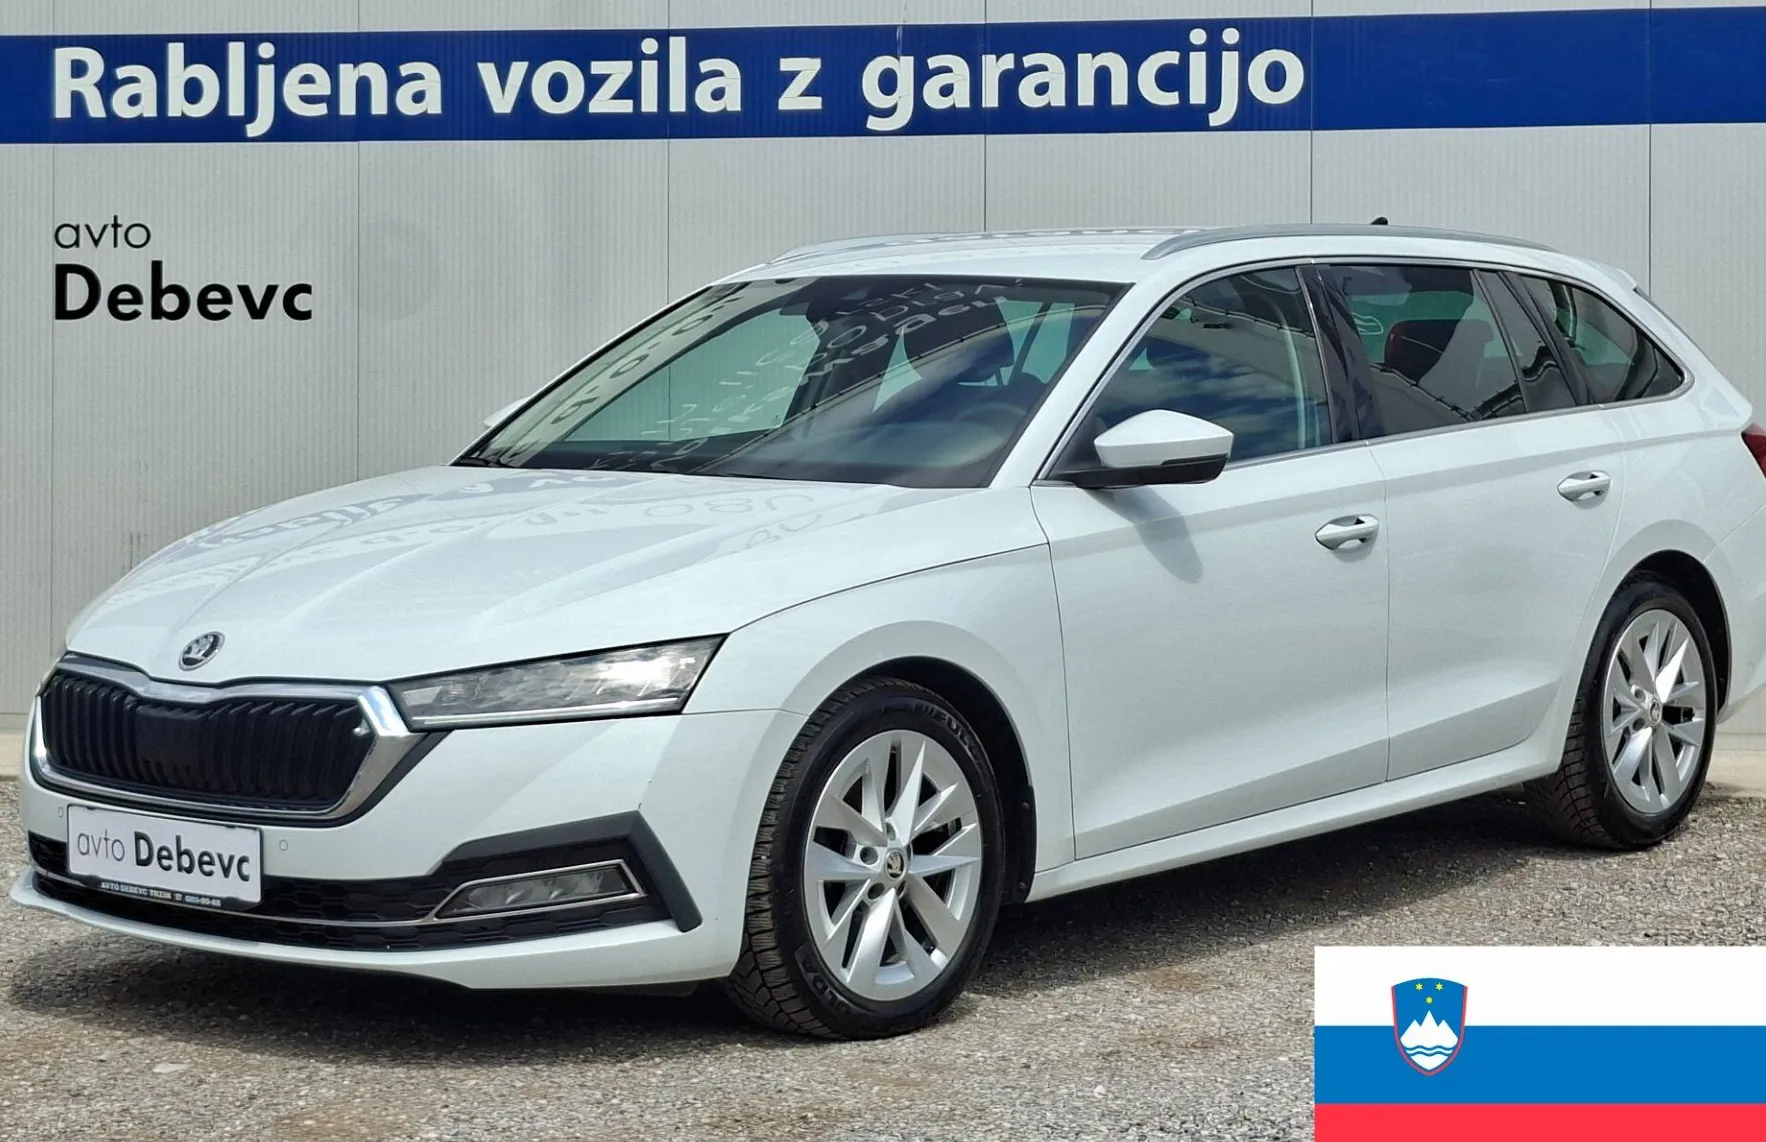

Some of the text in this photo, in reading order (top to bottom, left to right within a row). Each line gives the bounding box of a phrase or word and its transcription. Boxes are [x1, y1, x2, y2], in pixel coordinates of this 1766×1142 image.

[53, 27, 1305, 138] Rabljena vozila z garancijo
[54, 214, 151, 249] avto
[54, 260, 313, 322] Debevc
[77, 830, 251, 881] avto Debevc
[100, 881, 120, 891] AVTO
[120, 884, 148, 896] DEBEVC
